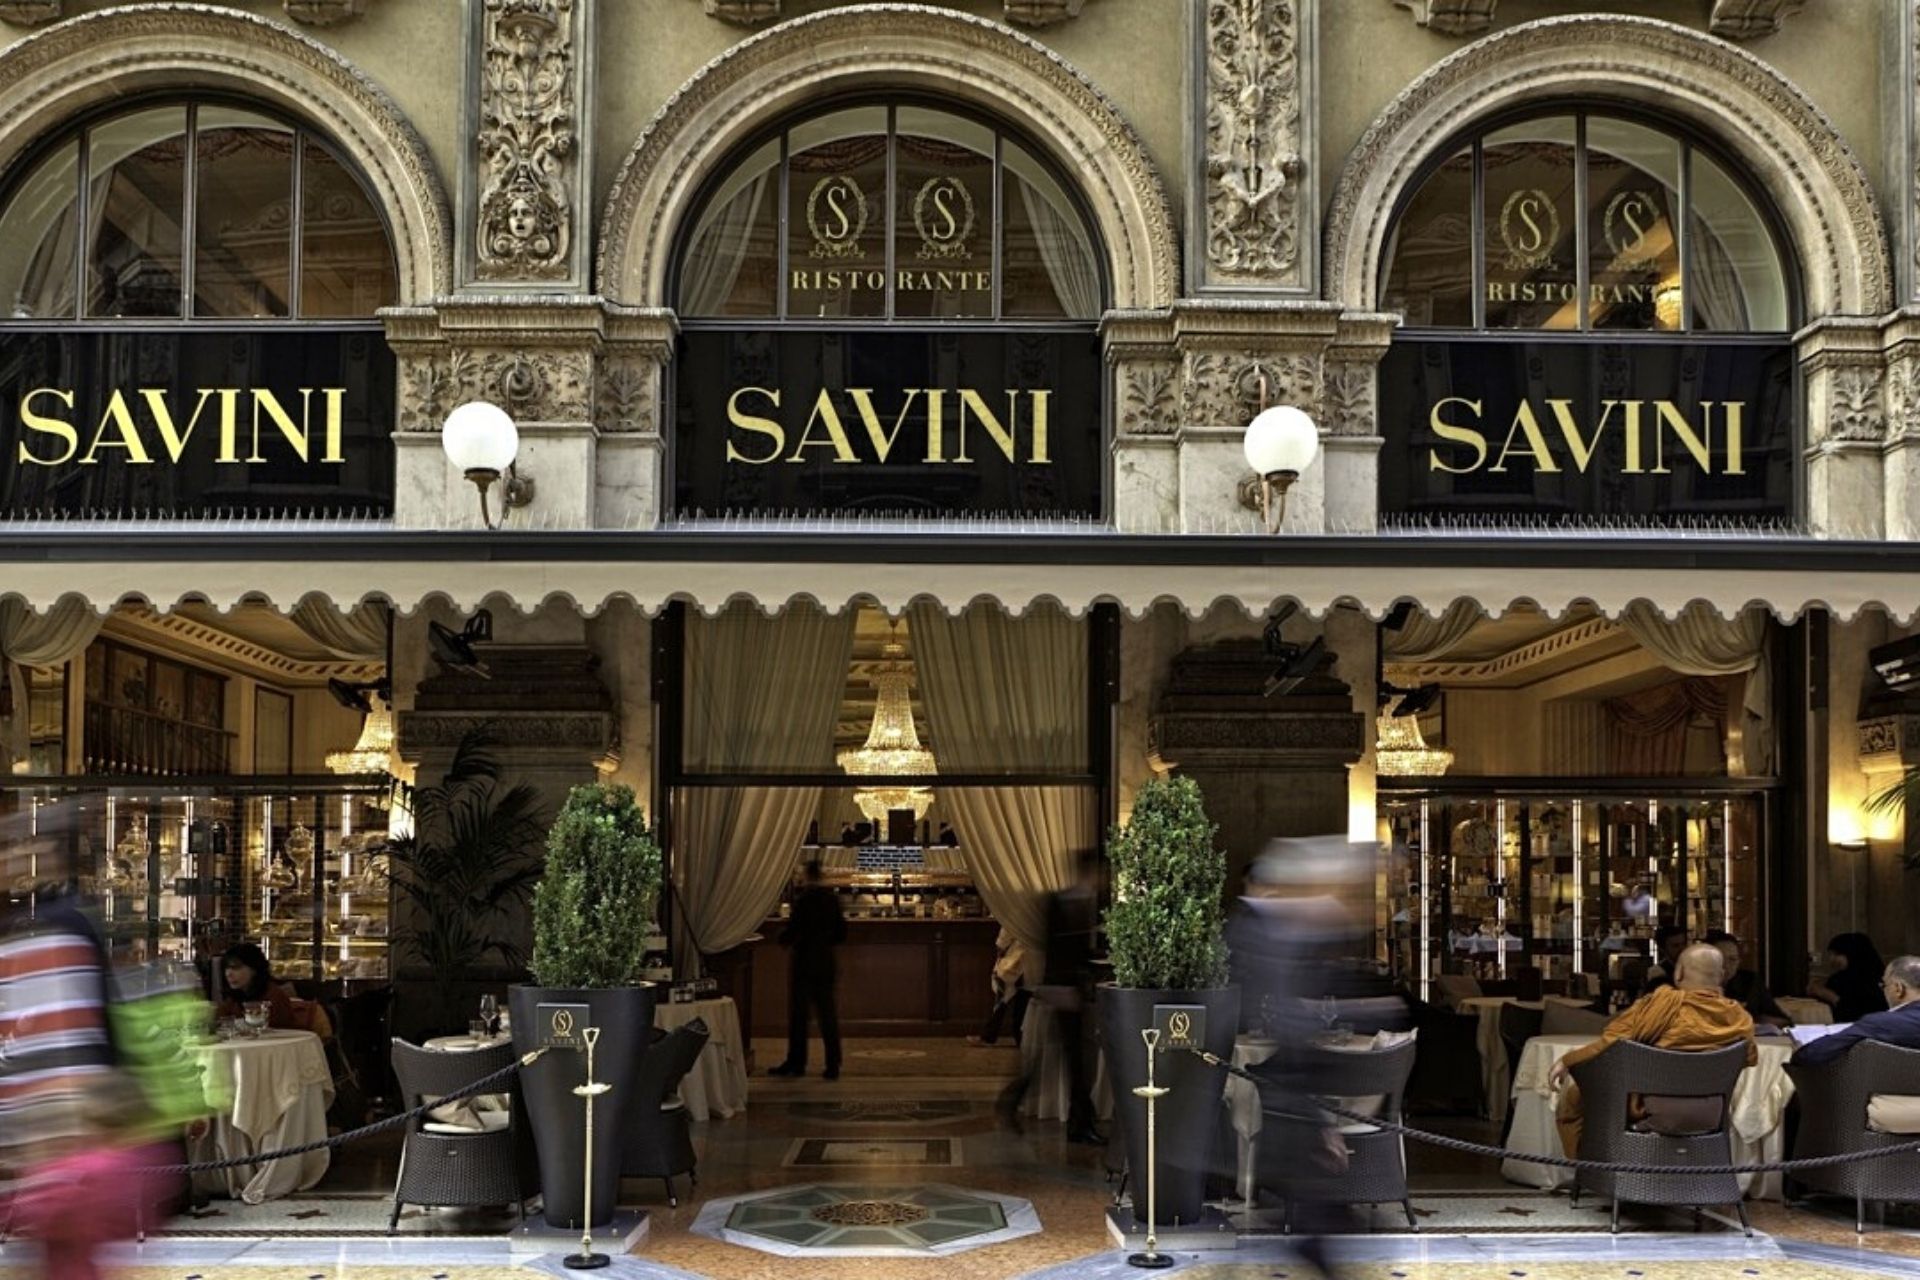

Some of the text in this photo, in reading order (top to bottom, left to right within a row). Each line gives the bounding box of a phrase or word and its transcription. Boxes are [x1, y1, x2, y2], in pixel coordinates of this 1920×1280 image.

[1488, 282, 1682, 304] RISTORANT
[18, 388, 344, 466] SAVINI
[726, 387, 1053, 464] SAVINI
[1430, 397, 1746, 475] SAVINI
